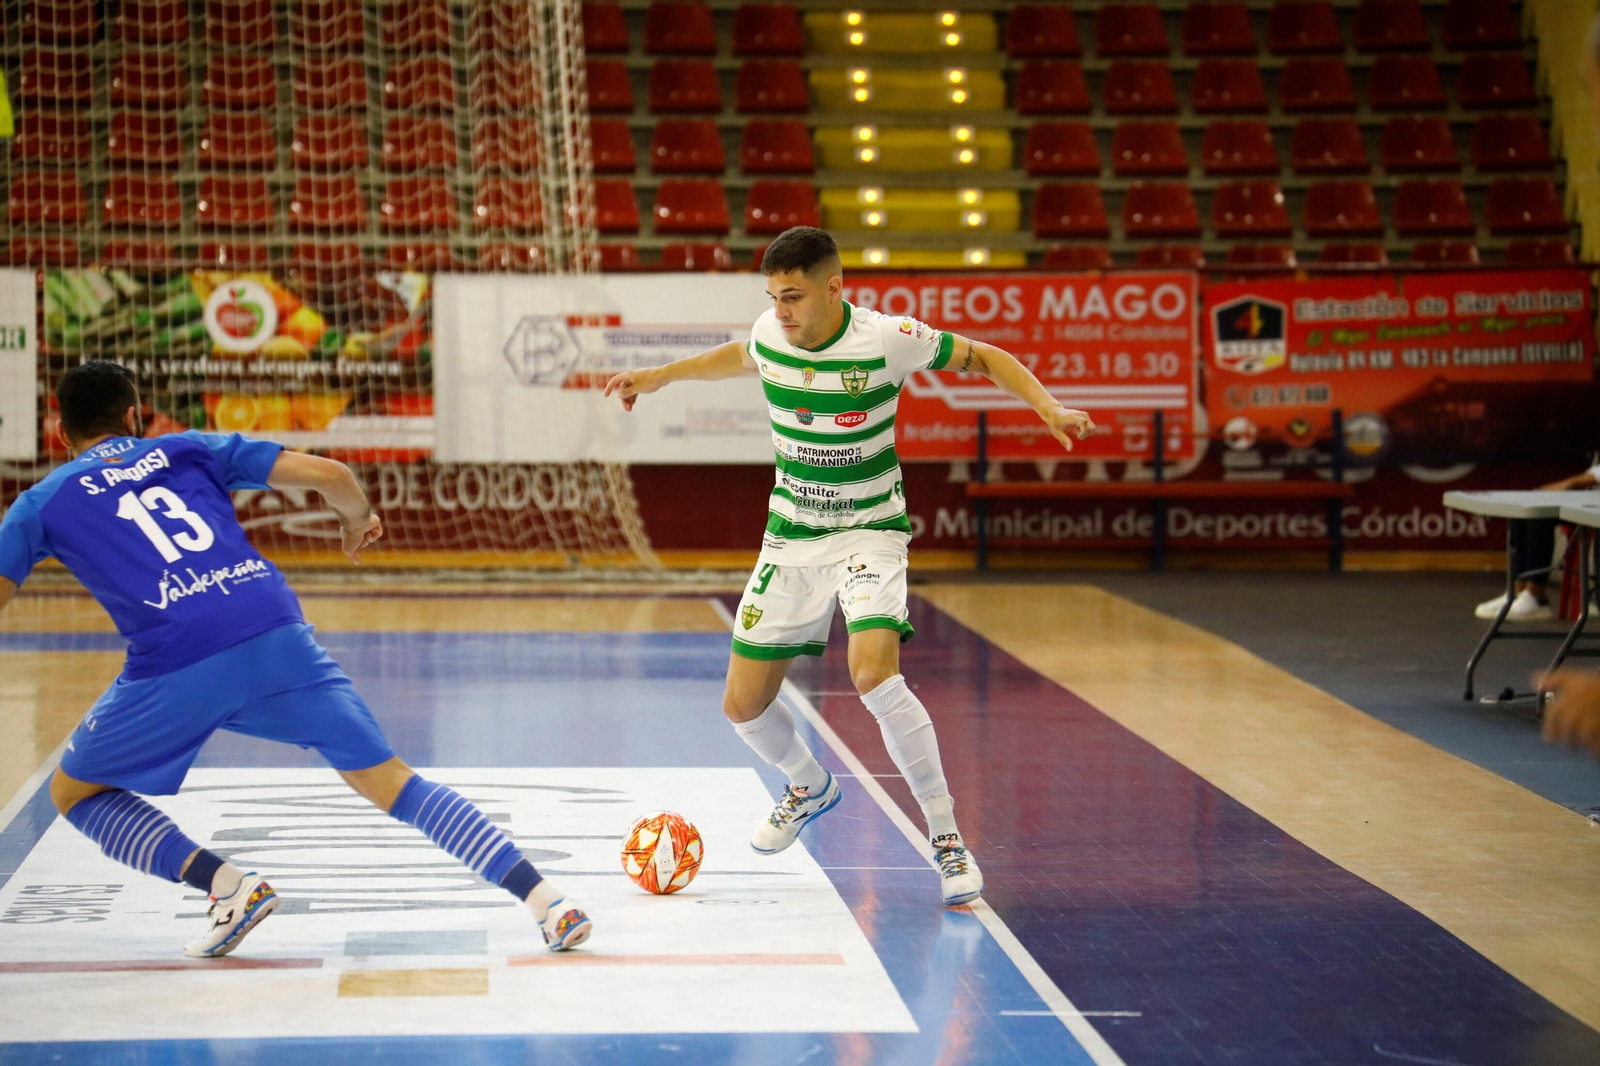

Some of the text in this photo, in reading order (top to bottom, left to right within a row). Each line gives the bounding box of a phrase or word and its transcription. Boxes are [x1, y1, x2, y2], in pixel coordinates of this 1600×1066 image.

[1039, 284, 1187, 321] MAGO
[1415, 295, 1448, 318] de
[957, 352, 1180, 380] 7.23.18.30
[797, 446, 854, 458] PATRIMONIO
[797, 455, 863, 467] HUMANIDAD
[79, 475, 106, 495] S.
[379, 466, 425, 509] DE
[795, 496, 854, 511] Catedral
[116, 486, 214, 564] 13
[934, 508, 1103, 541] Municipal
[1112, 508, 1154, 538] de
[1167, 507, 1328, 541] Deportes
[1340, 506, 1487, 538] Córdoba
[752, 563, 777, 595] 9
